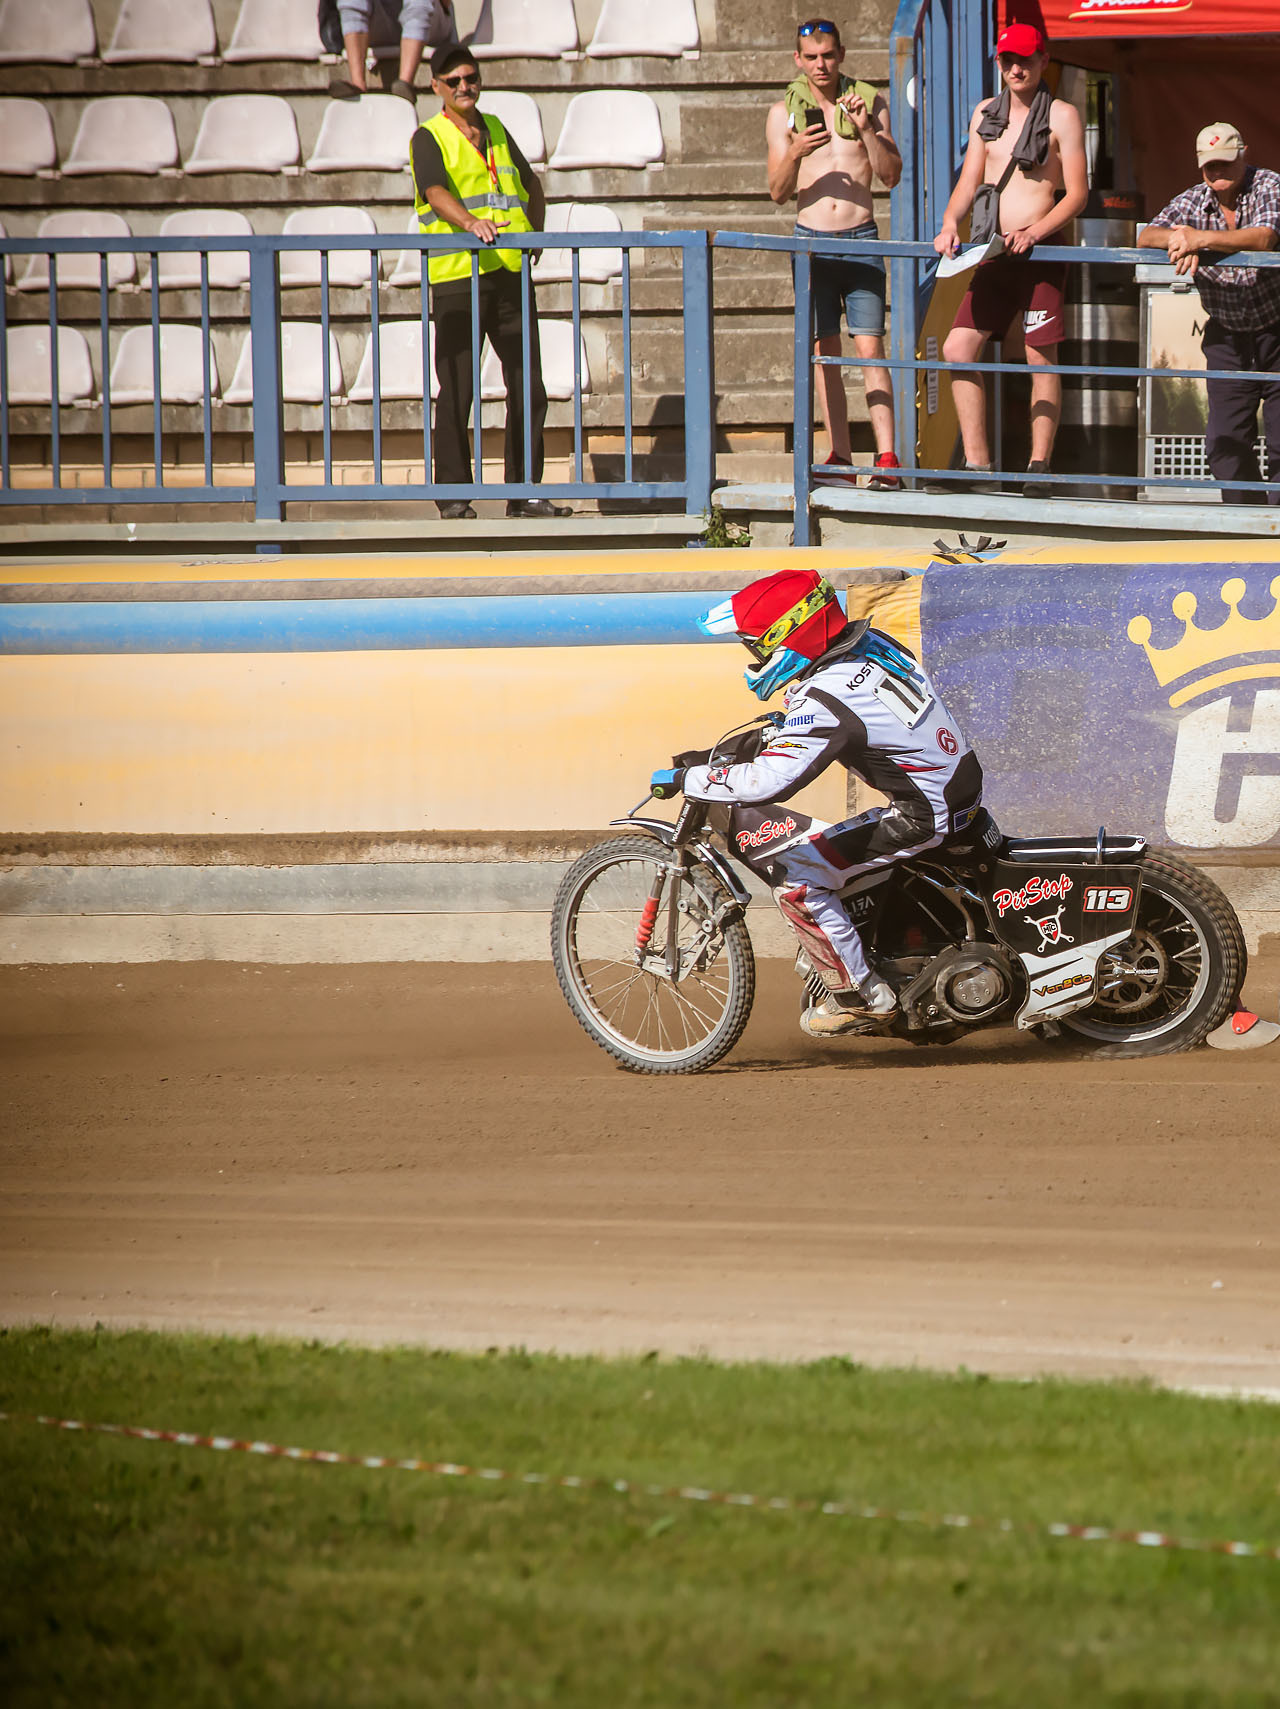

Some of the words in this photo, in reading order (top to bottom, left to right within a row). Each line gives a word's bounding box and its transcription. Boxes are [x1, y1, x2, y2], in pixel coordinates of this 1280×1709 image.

[736, 816, 796, 852] PitStop
[993, 873, 1073, 918] PitStop
[1086, 889, 1130, 910] 113
[1032, 974, 1093, 997] Van2Go
